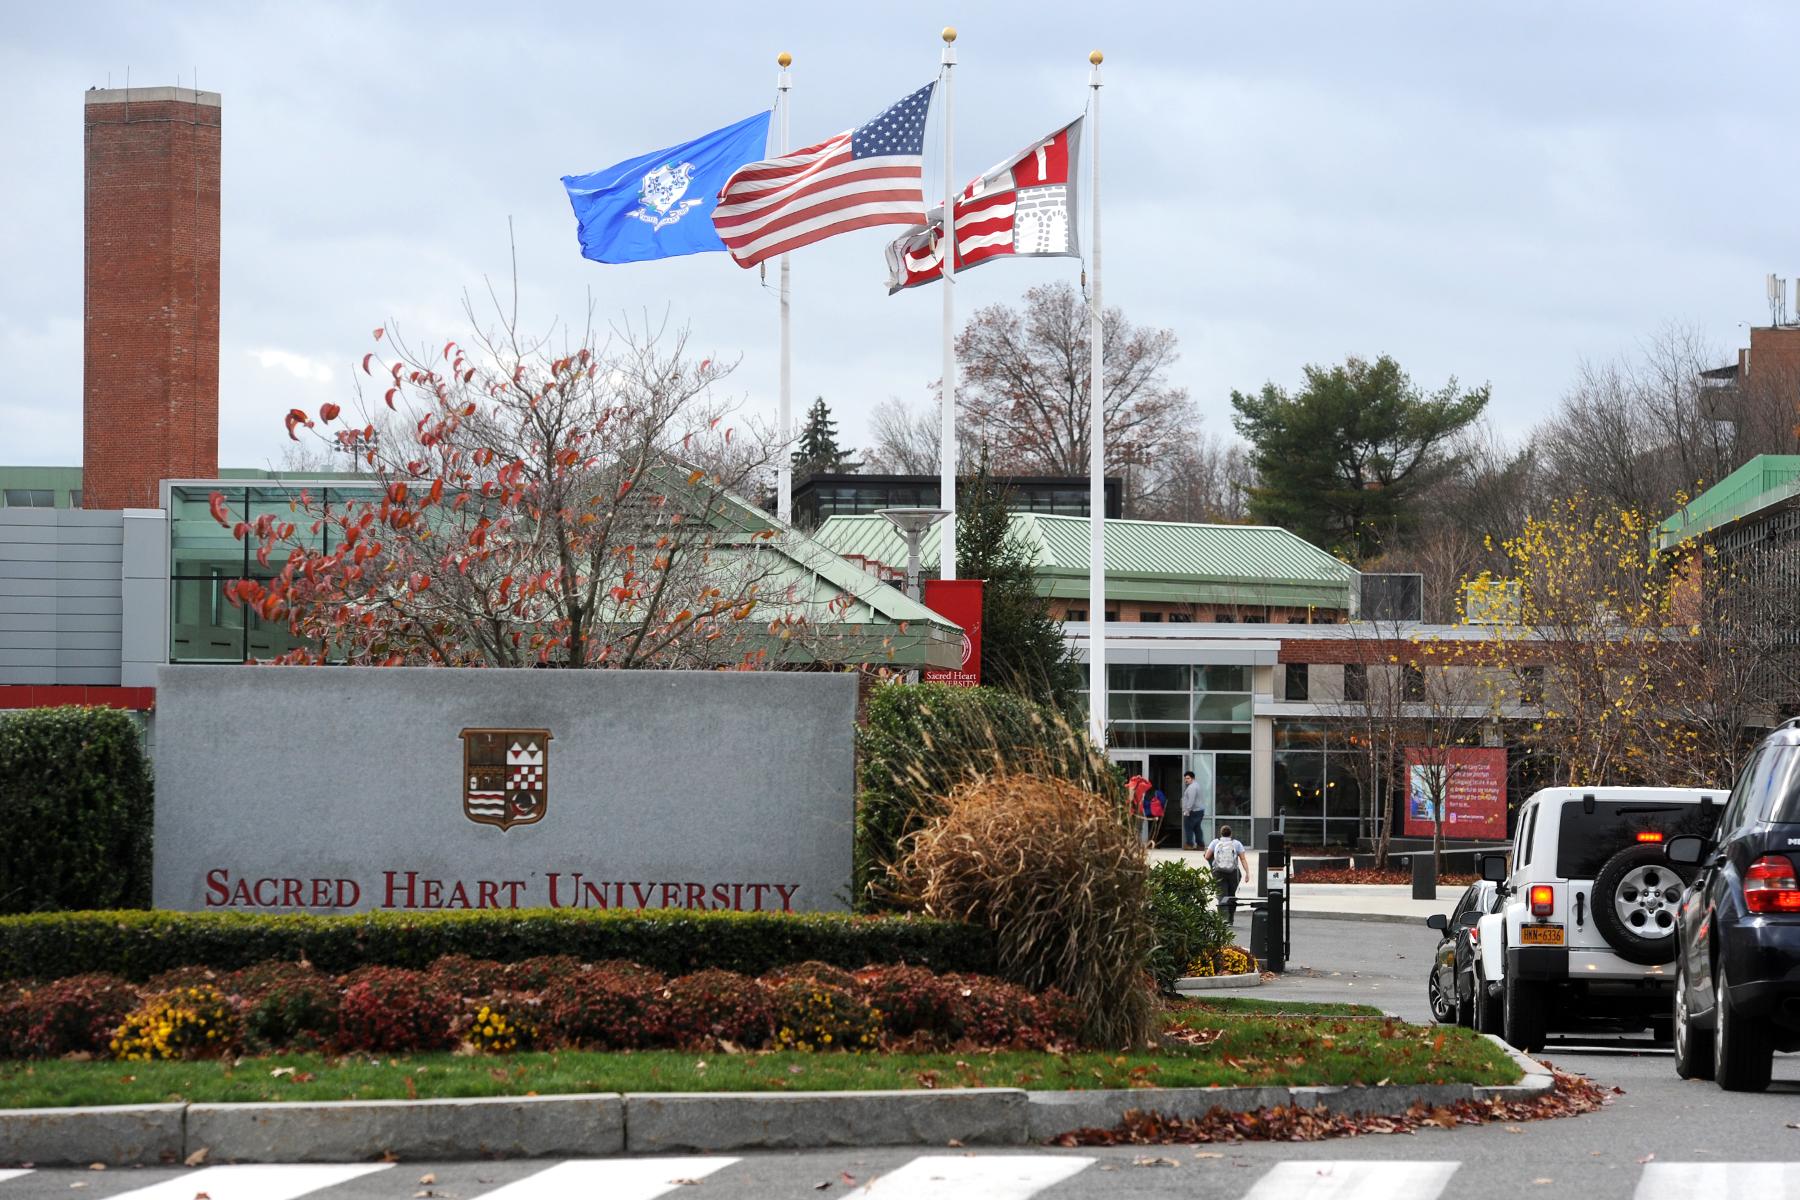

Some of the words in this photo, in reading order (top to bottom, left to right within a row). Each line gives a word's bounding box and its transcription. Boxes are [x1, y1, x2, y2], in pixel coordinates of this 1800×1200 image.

[926, 671, 952, 680] Sacred
[954, 671, 977, 680] Heart
[205, 869, 361, 908] SACRED
[381, 871, 527, 909] HEART
[545, 873, 800, 911] UNIVERSITY
